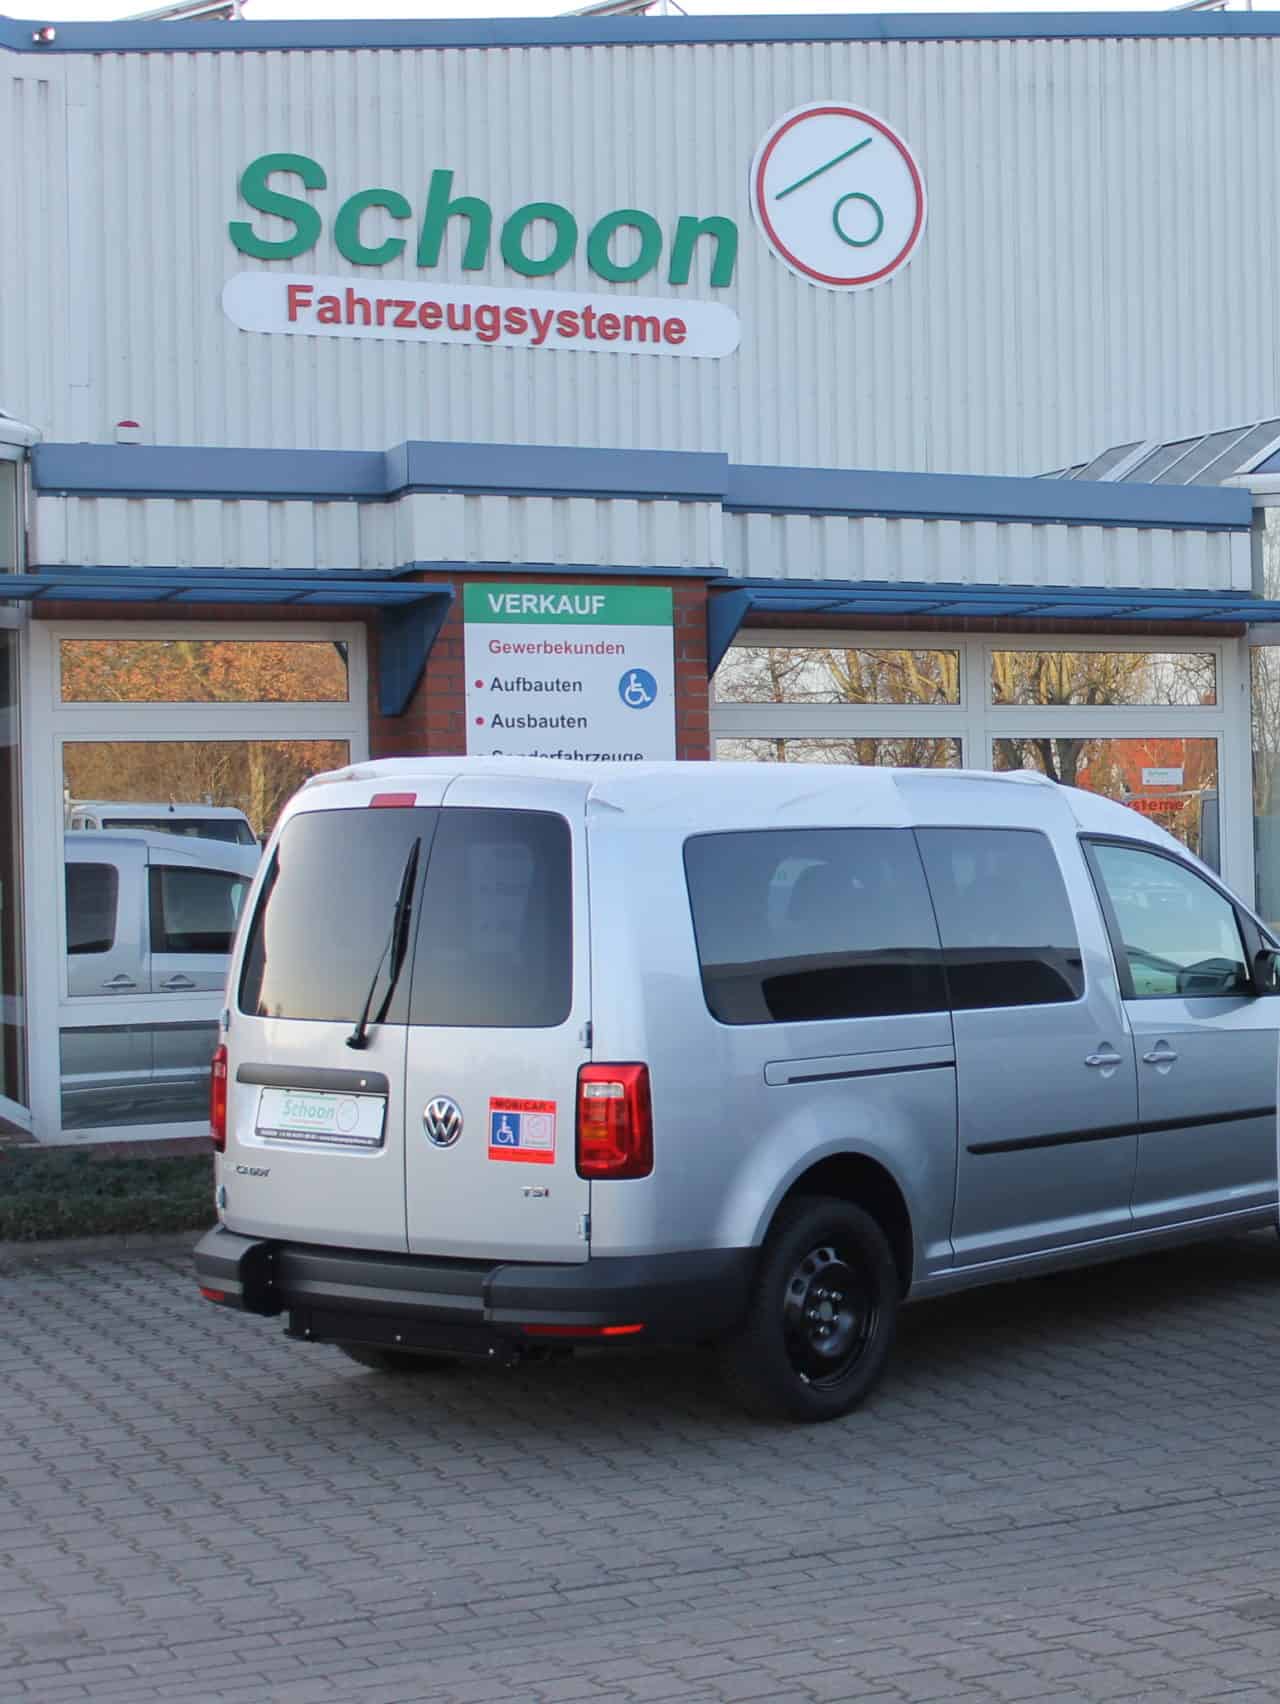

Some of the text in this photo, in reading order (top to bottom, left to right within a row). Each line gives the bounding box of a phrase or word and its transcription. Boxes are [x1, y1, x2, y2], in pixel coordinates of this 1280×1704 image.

[229, 152, 739, 288] Schoon
[286, 284, 688, 346] Fahrzeugsysteme
[488, 593, 606, 615] VERKAUF
[488, 639, 625, 655] Gewerbekunden
[490, 677, 583, 692] Aufbauten
[490, 714, 588, 729] Ausbauten
